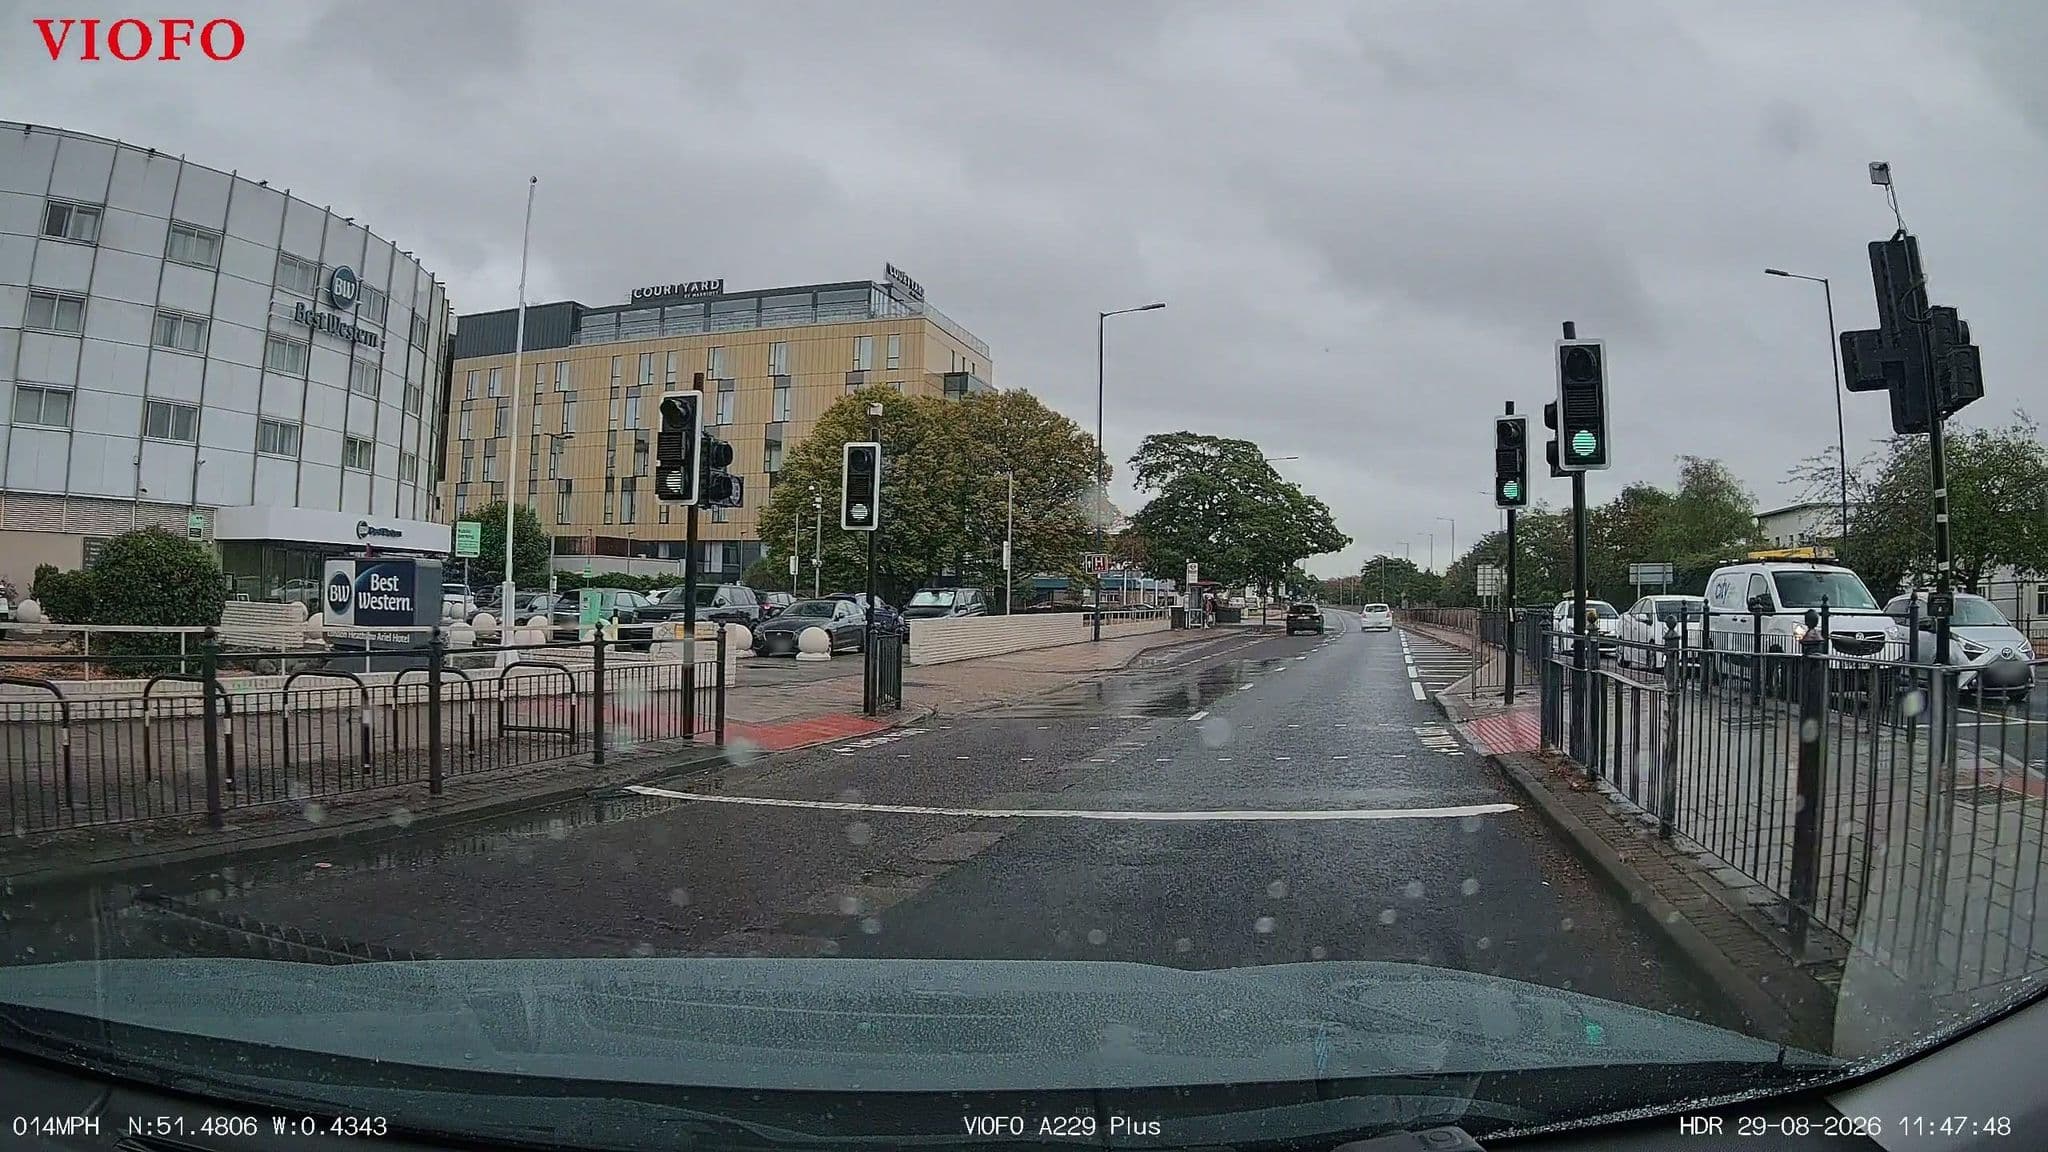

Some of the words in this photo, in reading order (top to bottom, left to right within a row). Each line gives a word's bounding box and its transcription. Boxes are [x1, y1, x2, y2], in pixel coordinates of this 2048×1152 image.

[334, 278, 356, 300] BW
[633, 280, 720, 299] COURTYARD
[294, 301, 328, 330] Best
[326, 313, 379, 348] Western
[370, 573, 400, 592] Best
[329, 584, 350, 602] BW
[376, 633, 392, 642] Ariel
[392, 634, 410, 643] Hotel
